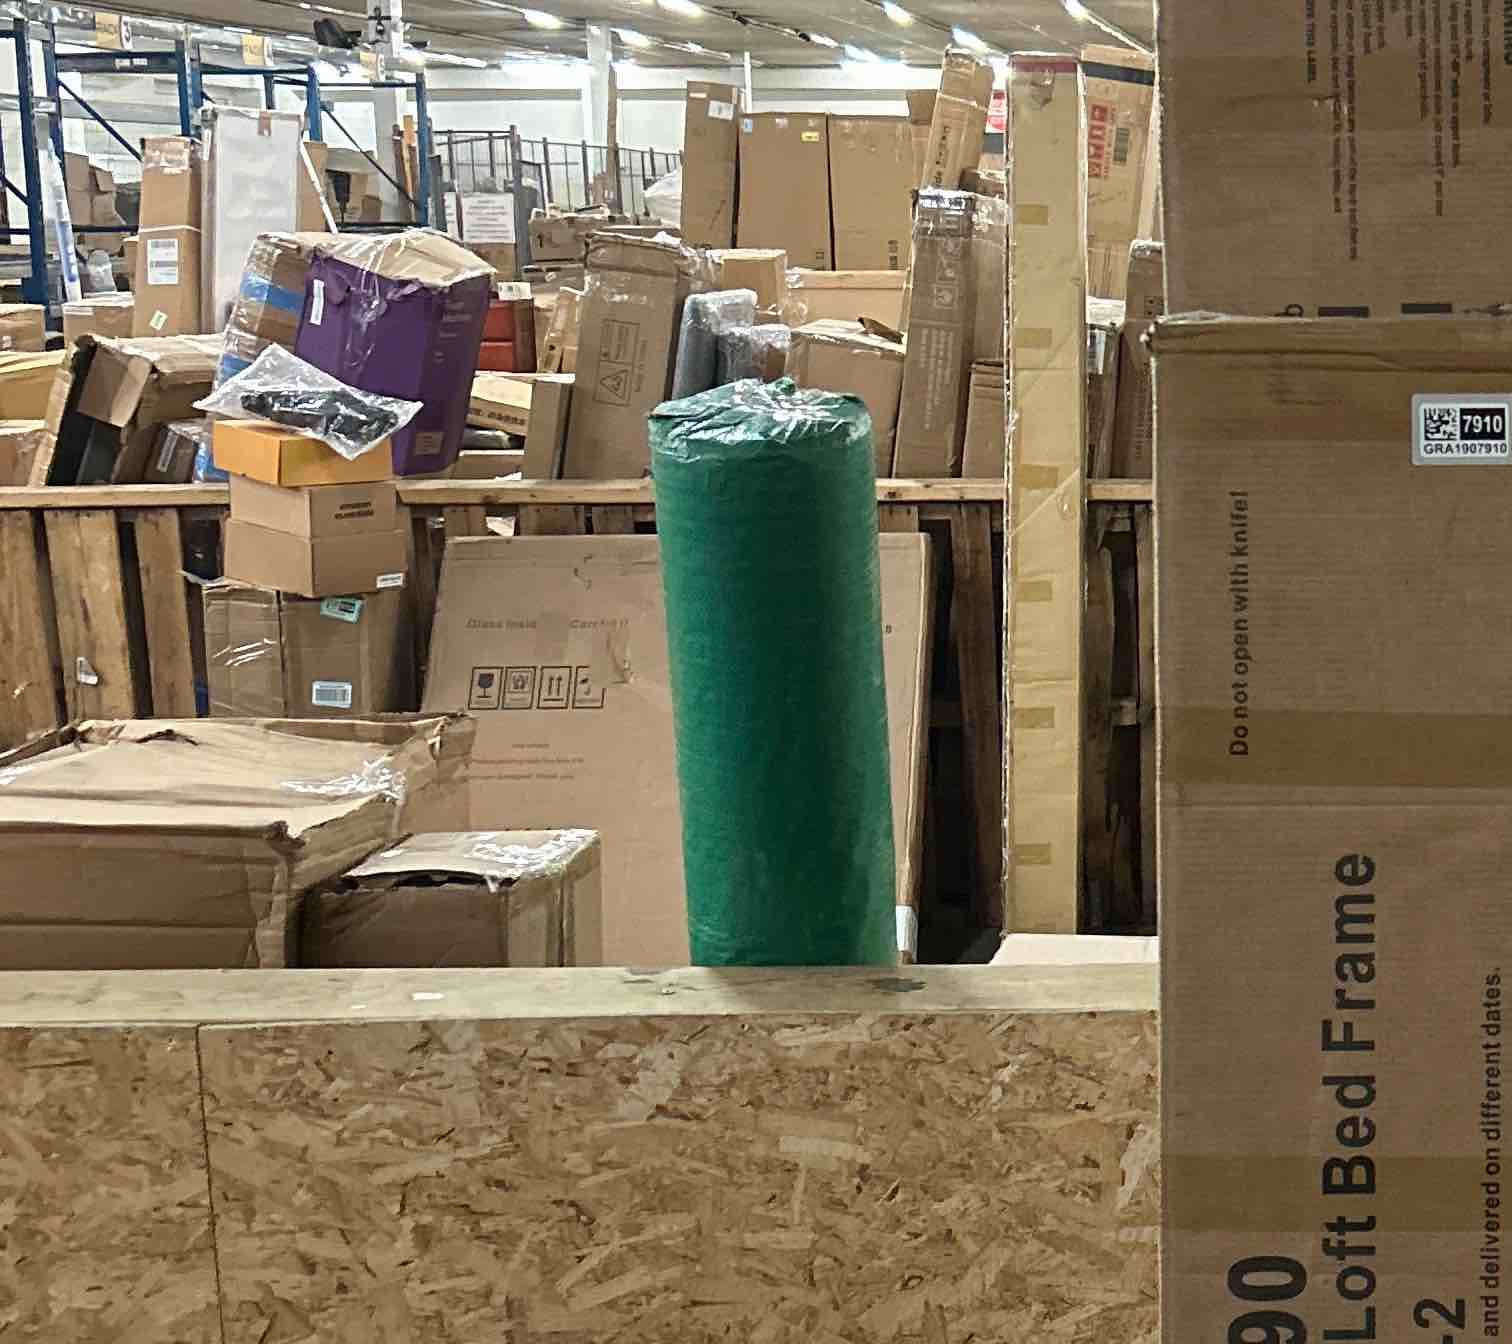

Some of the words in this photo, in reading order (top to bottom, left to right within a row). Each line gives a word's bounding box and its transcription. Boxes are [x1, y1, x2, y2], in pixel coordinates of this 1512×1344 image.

[1462, 415, 1503, 433] 7910
[1228, 490, 1249, 557] knife!
[1228, 562, 1249, 612] with
[1232, 618, 1254, 676] open
[1230, 682, 1249, 720] not
[1229, 725, 1249, 756] Do
[1321, 854, 1377, 1053] Frame
[1479, 967, 1501, 1037] dates.
[1479, 1043, 1501, 1142] different
[1321, 1074, 1377, 1195] Bed
[1485, 1148, 1501, 1175] on
[1479, 1182, 1500, 1289] delivered
[1321, 1216, 1377, 1341] Loft
[1479, 1296, 1499, 1337] and
